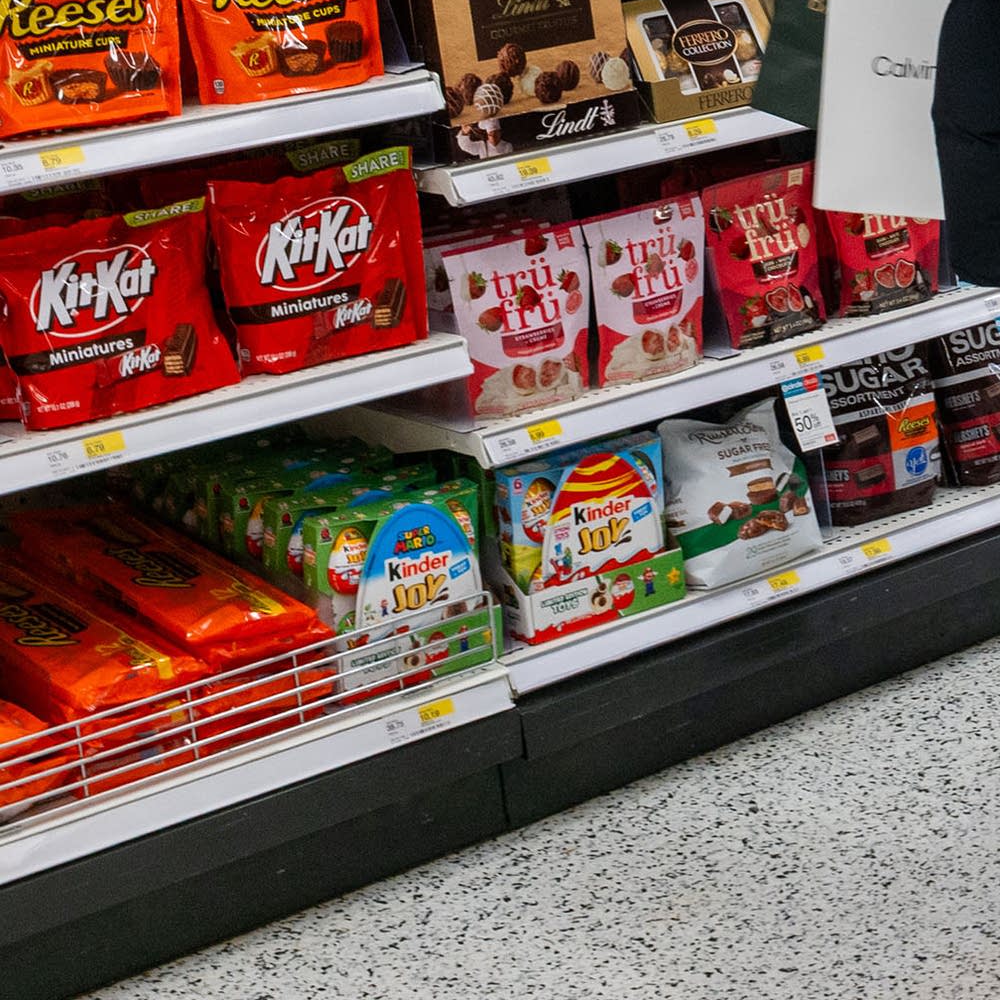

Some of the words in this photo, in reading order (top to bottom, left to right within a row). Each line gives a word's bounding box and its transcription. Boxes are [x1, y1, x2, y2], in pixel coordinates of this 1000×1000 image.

[312, 5, 341, 18] CUPS
[29, 38, 94, 55] MINIATURE
[95, 36, 122, 47] CUPS
[679, 28, 729, 48] FERRERO
[682, 40, 733, 57] COLLECTION
[536, 108, 599, 141] Lindt
[351, 152, 399, 178] SHARE
[134, 202, 191, 223] SHARE
[733, 193, 788, 232] trü
[260, 205, 374, 285] KitKat
[624, 227, 678, 267] trü
[744, 221, 799, 262] frü
[36, 250, 157, 332] KitKat
[490, 257, 557, 300] trü
[630, 264, 683, 300] frü
[270, 290, 349, 319] Miniatures
[333, 298, 372, 329] KitKat
[498, 291, 561, 333] frü
[49, 335, 134, 367] Miniatures
[949, 322, 1000, 355] SUG
[119, 344, 161, 378] KitKat
[822, 358, 929, 397] SUGAR
[829, 387, 905, 410] SSORTMENT
[899, 416, 930, 433] Reese's
[718, 444, 752, 460] SUGAR
[514, 479, 522, 490] 6
[394, 534, 437, 555] MARIO
[398, 525, 431, 540] SUPER
